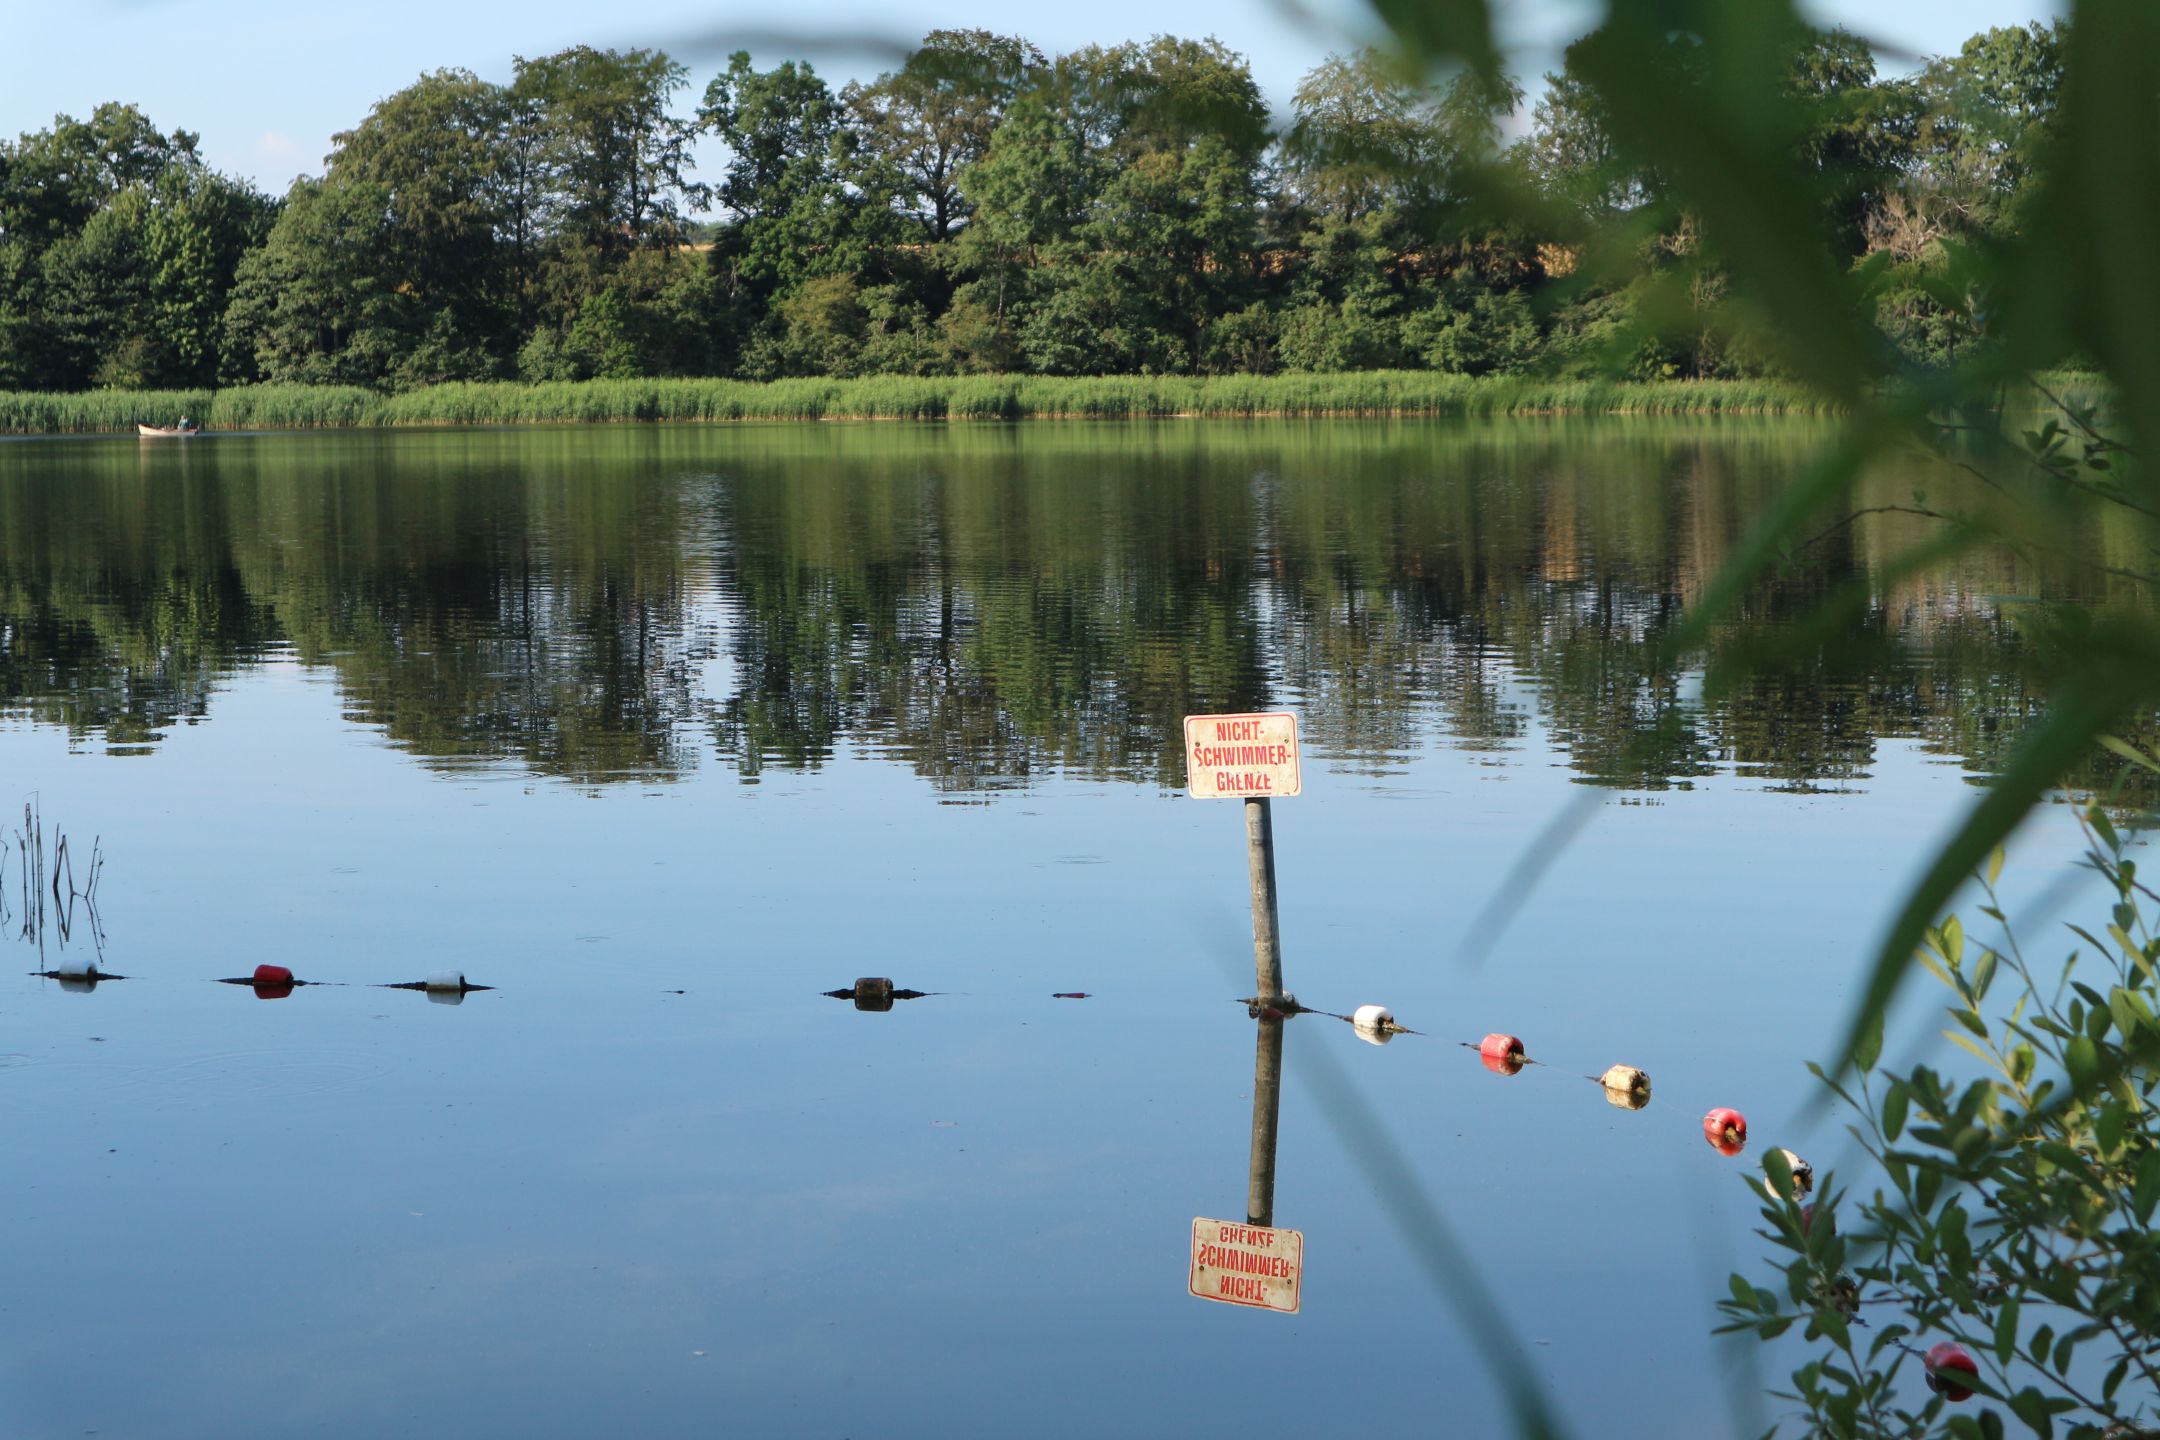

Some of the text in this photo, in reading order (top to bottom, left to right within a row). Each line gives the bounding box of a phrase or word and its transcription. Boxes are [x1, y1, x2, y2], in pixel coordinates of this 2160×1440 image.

[1216, 720, 1265, 742] NICHT-
[1193, 745, 1292, 767] SCHWIMMER-
[1216, 771, 1272, 792] GRENZE
